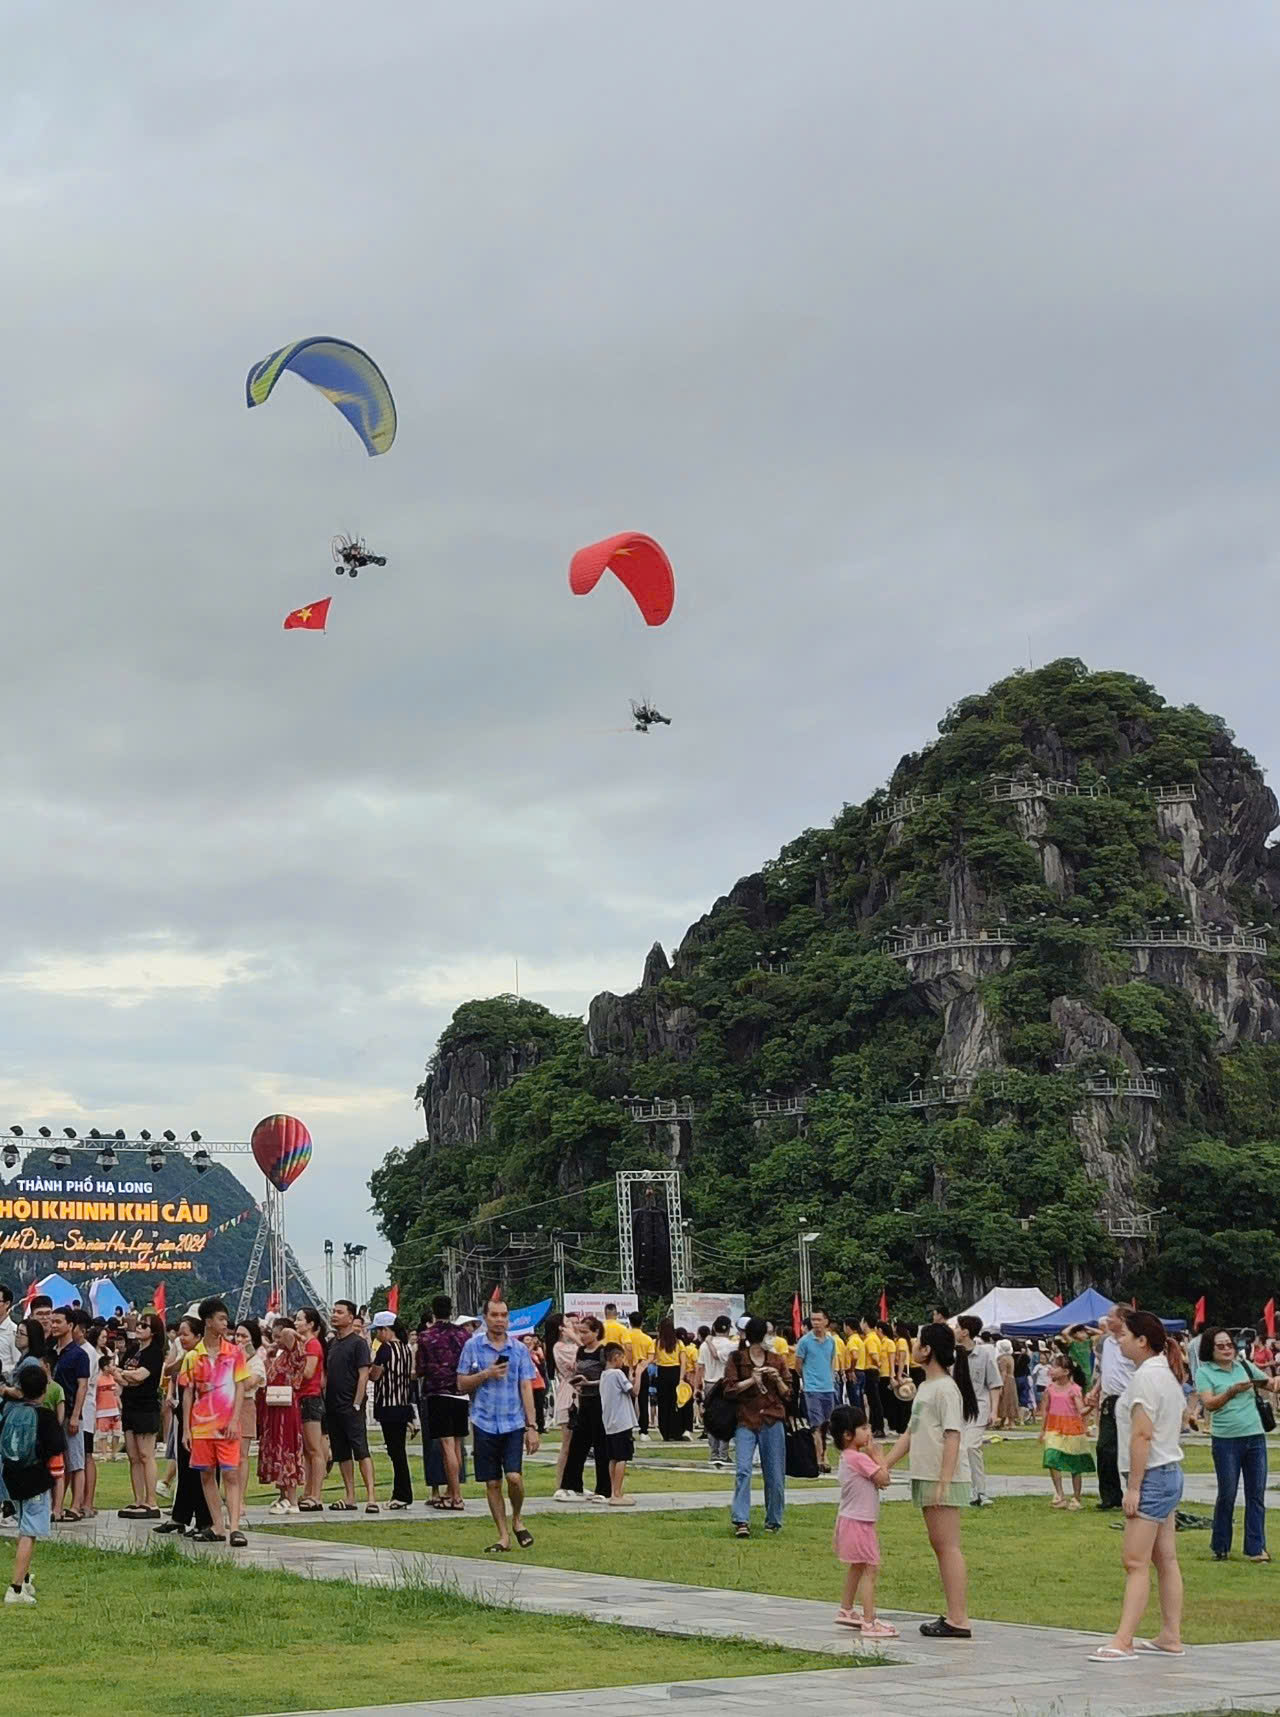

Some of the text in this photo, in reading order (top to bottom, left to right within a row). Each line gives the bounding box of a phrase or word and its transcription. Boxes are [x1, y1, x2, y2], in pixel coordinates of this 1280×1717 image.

[16, 1174, 154, 1196] THÀNH PHỐ HẠ LONG
[41, 1200, 115, 1221] KHINH
[118, 1200, 159, 1222] KHÍ
[161, 1197, 209, 1223] CẦU
[106, 1230, 127, 1254] Hạ
[175, 1233, 207, 1252] 2024
[57, 1261, 68, 1271] Hạ
[69, 1261, 86, 1271] Long
[90, 1260, 107, 1271] ngày
[129, 1259, 150, 1271] tháng
[157, 1260, 172, 1270] năm
[173, 1261, 192, 1270] 2024
